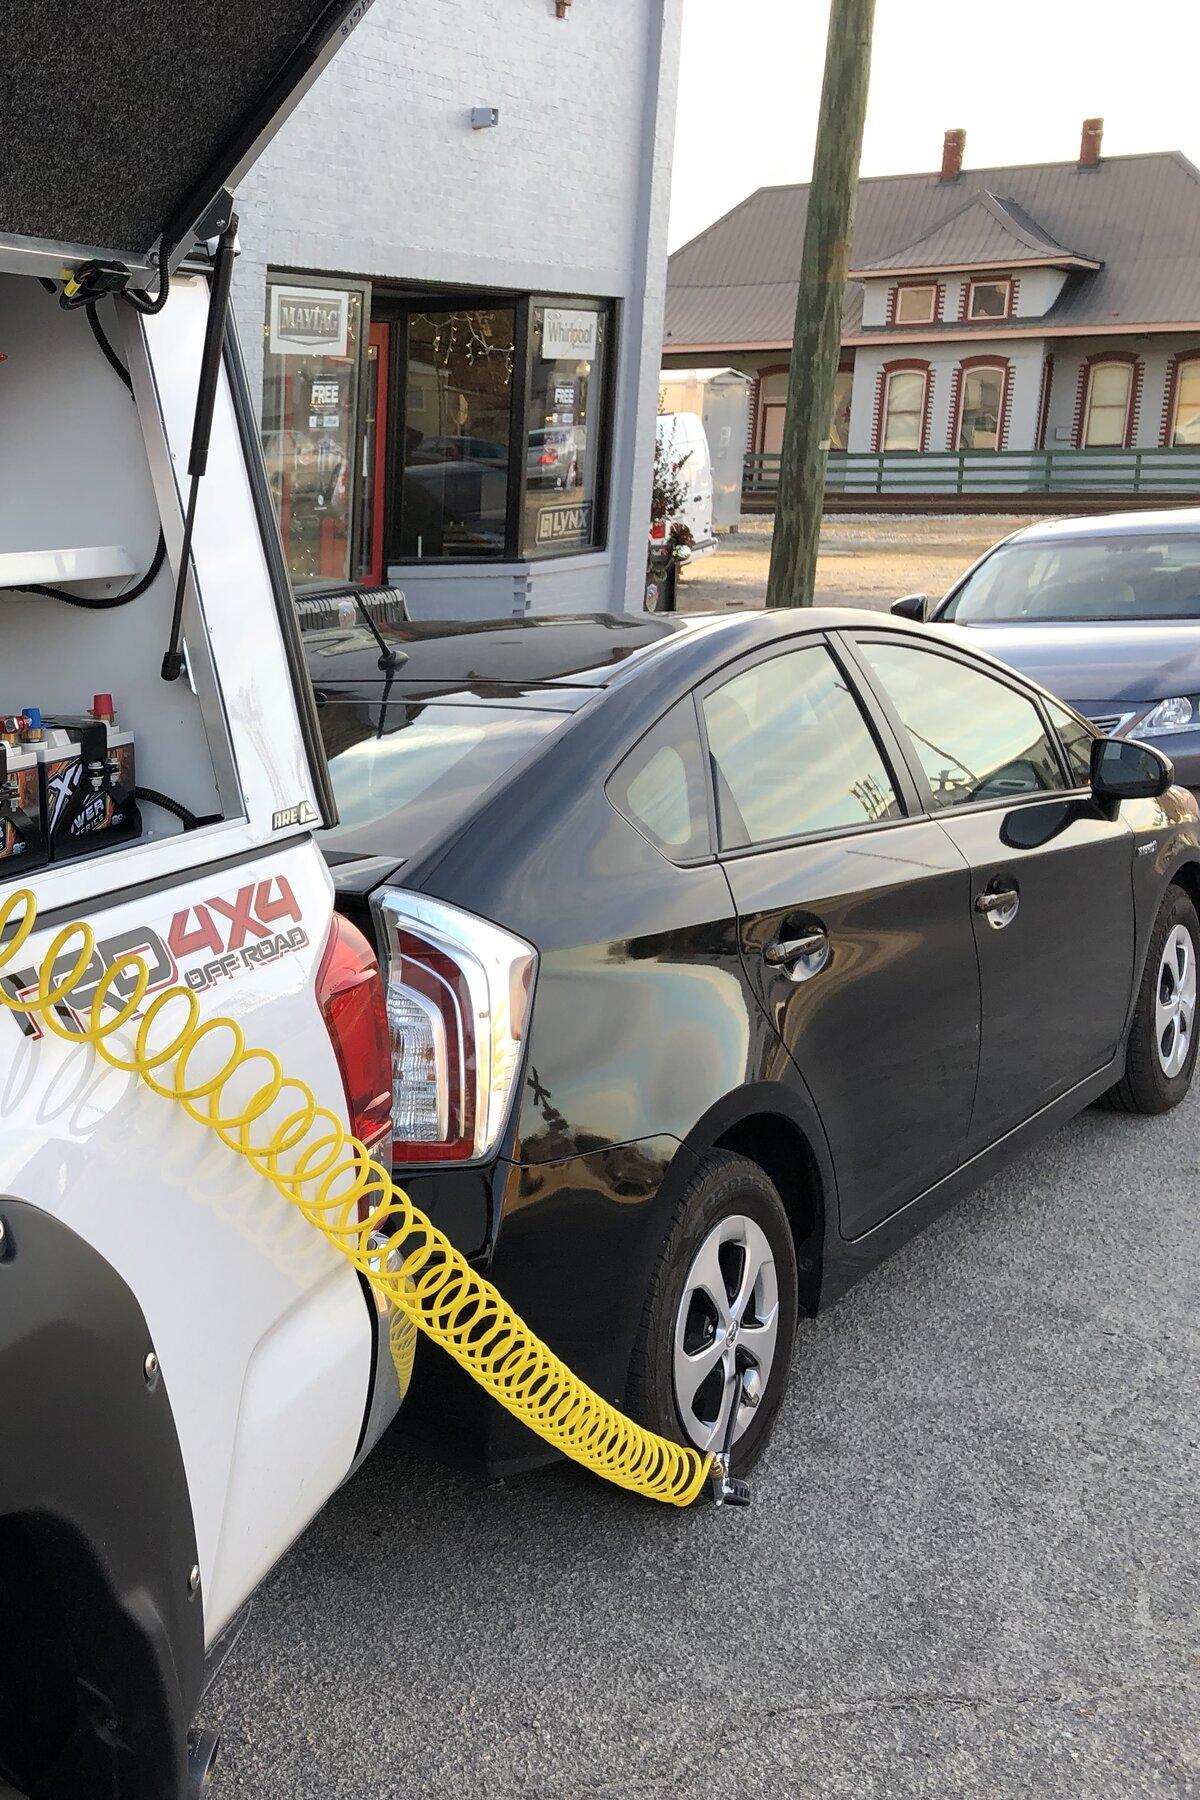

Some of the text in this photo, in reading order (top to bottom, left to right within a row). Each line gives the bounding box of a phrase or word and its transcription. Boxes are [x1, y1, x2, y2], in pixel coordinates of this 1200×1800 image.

[281, 306, 338, 331] MAYTAG
[311, 384, 339, 404] FREE
[554, 388, 574, 404] FREE
[553, 509, 588, 536] LYNX
[273, 806, 299, 829] ARE
[166, 875, 303, 959] 4X4
[184, 926, 309, 992] OFF ROAD
